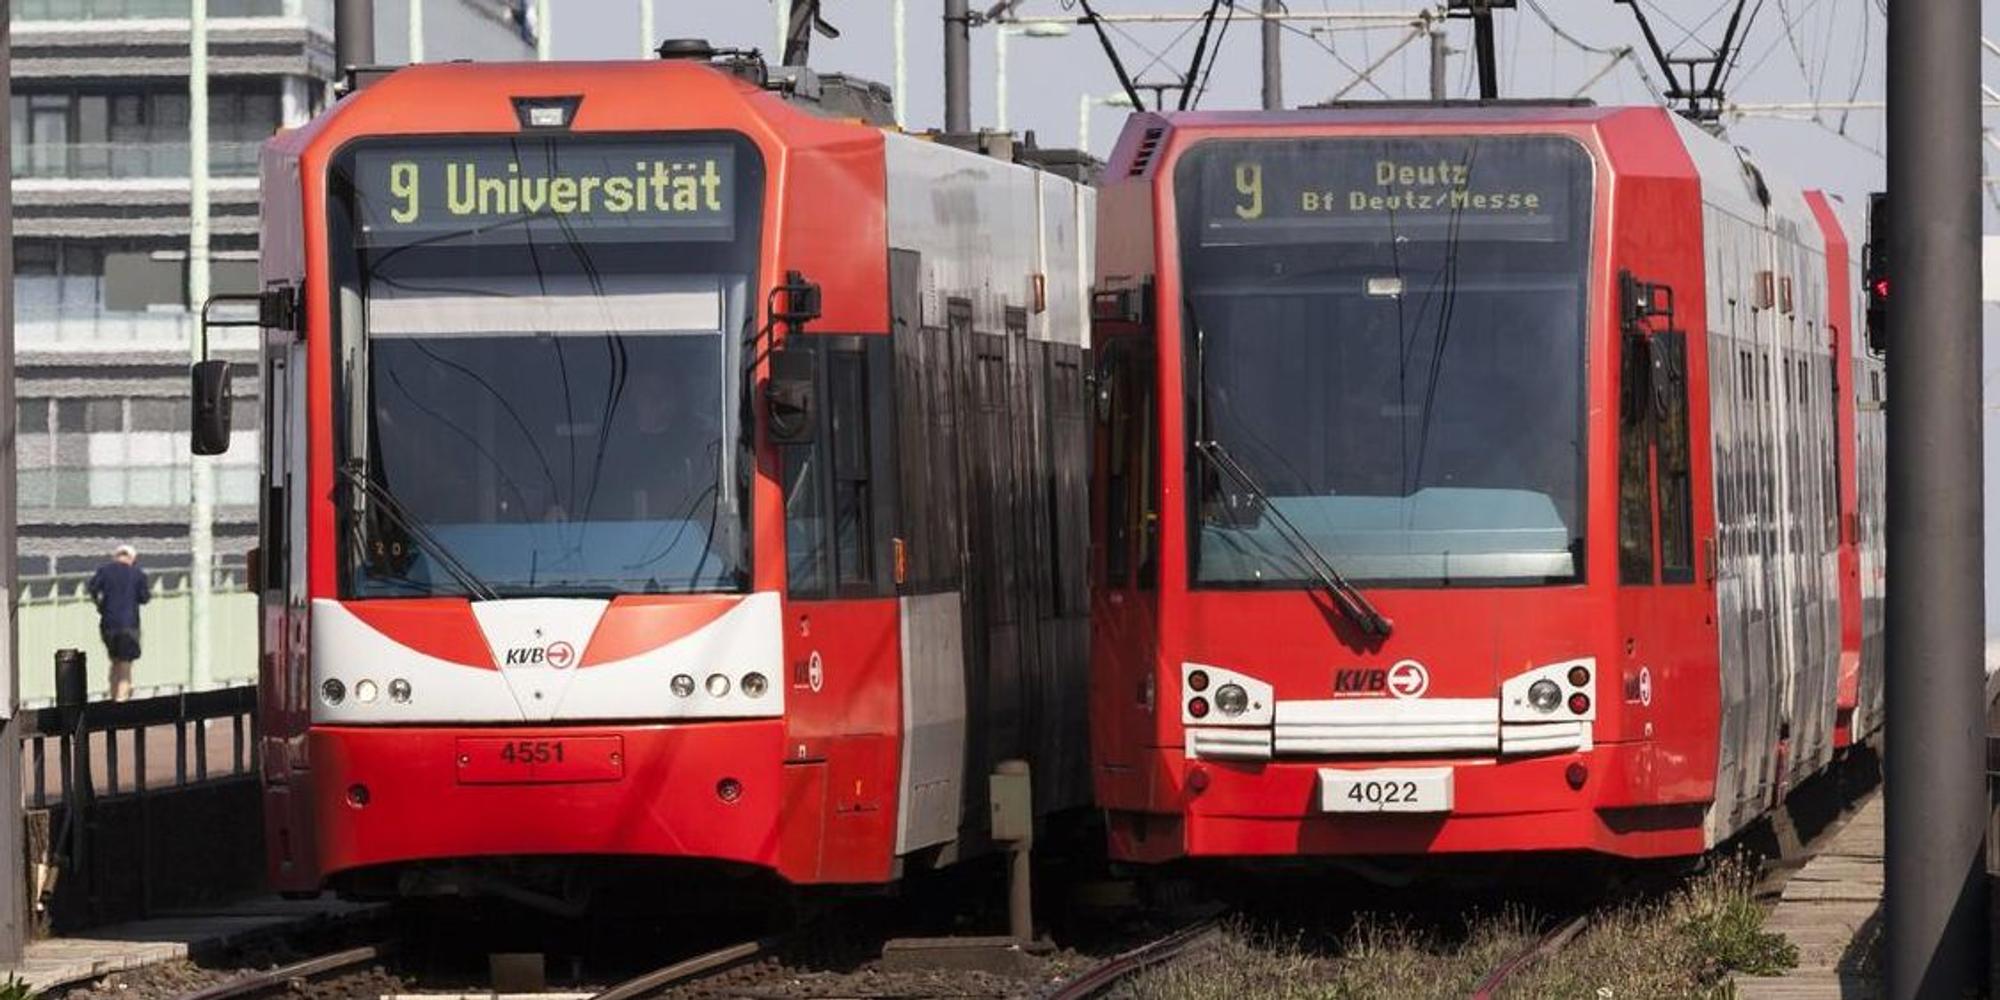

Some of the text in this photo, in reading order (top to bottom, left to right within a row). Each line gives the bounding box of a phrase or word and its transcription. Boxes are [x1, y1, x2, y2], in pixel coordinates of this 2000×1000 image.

[390, 160, 722, 224] 9 Universität
[1235, 160, 1469, 220] 9 Deutz
[1302, 191, 1335, 212] Bf
[506, 648, 545, 665] KVB
[1334, 668, 1387, 692] KVB
[501, 741, 564, 764] 4551
[1347, 780, 1419, 804] 4022
